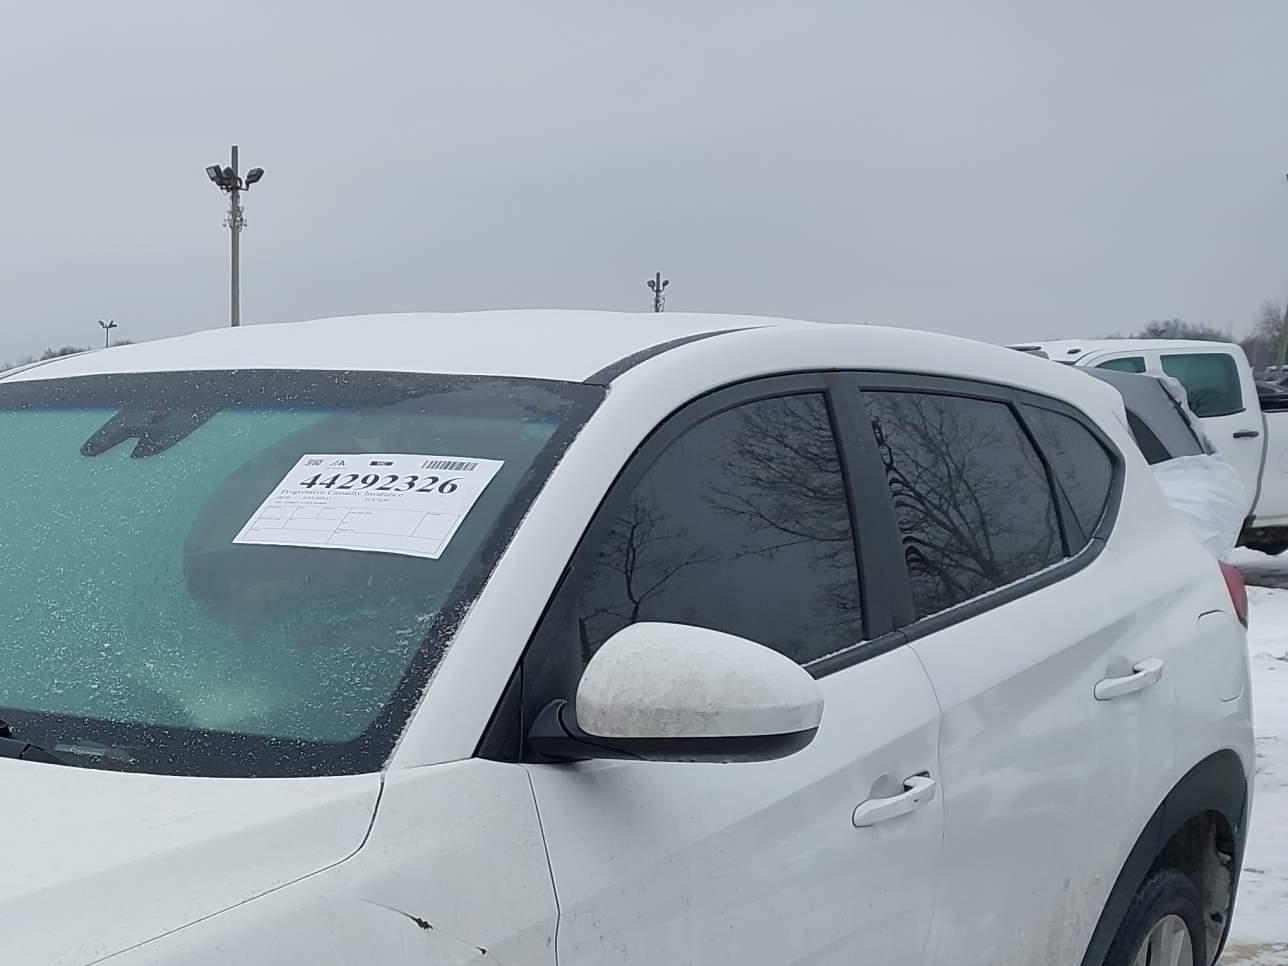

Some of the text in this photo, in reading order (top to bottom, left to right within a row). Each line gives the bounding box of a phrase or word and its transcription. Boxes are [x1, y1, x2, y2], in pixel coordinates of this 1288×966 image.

[299, 472, 464, 495] 44292326
[280, 489, 405, 498] Progressive Casualty Insurance
